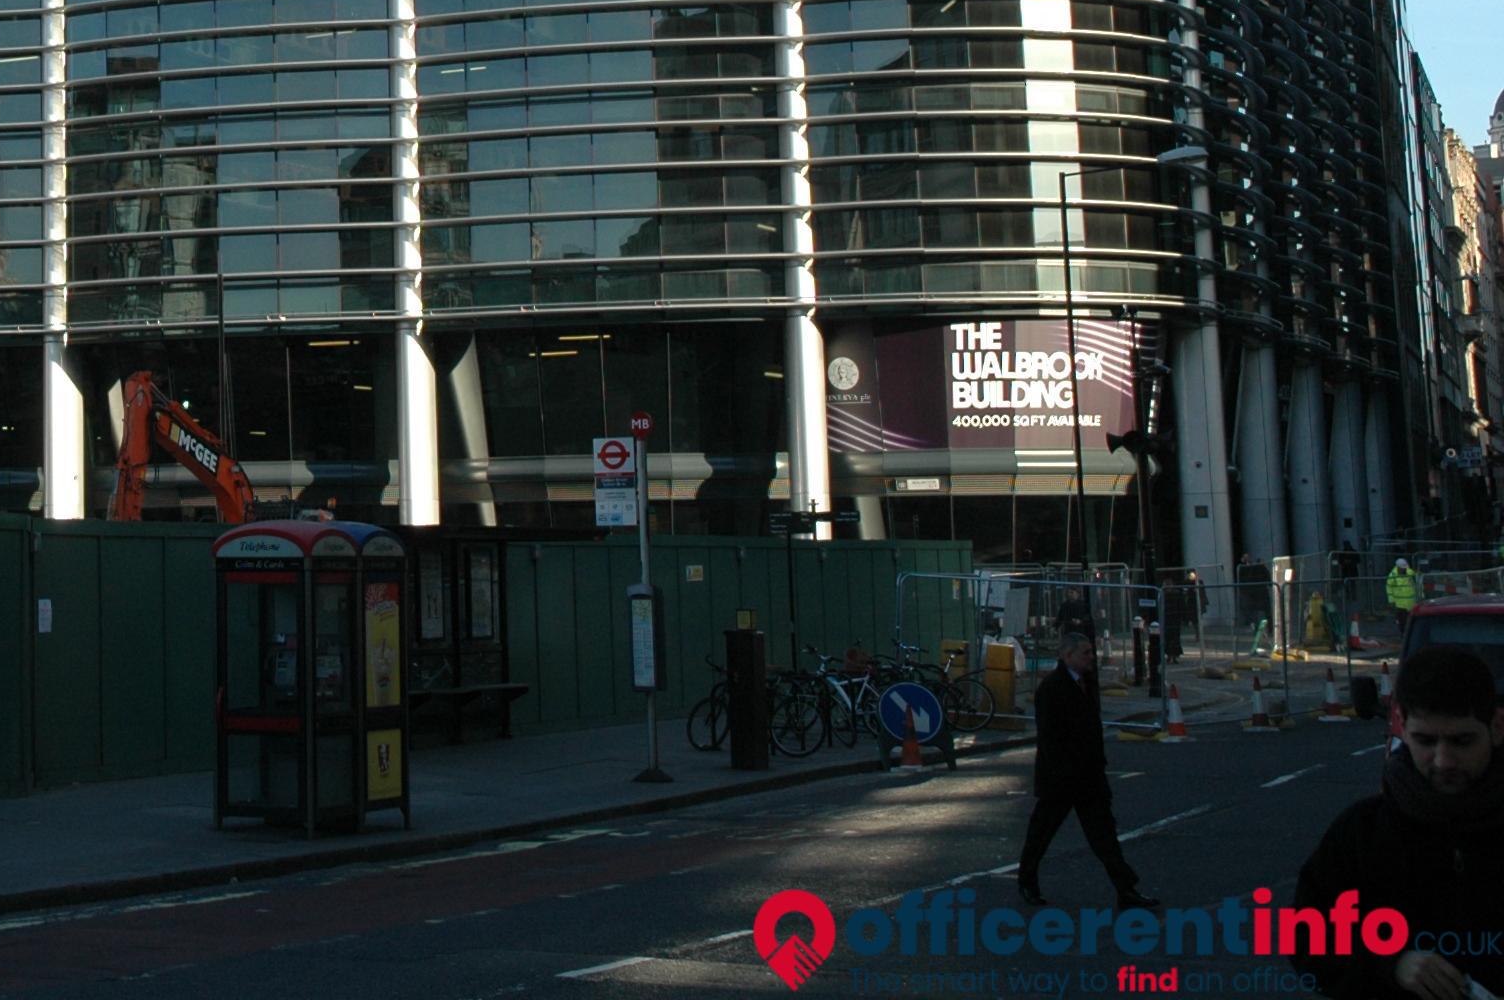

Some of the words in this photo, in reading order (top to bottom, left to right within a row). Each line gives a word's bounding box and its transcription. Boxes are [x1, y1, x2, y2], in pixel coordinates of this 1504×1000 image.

[950, 322, 1002, 350] THE
[951, 351, 1104, 381] WALBROOK
[952, 380, 1075, 409] BUILDING
[631, 418, 650, 430] MB
[952, 415, 1010, 429] 400,000
[1013, 415, 1029, 427] SQ
[1029, 415, 1046, 427] FT
[240, 541, 280, 552] Telephone
